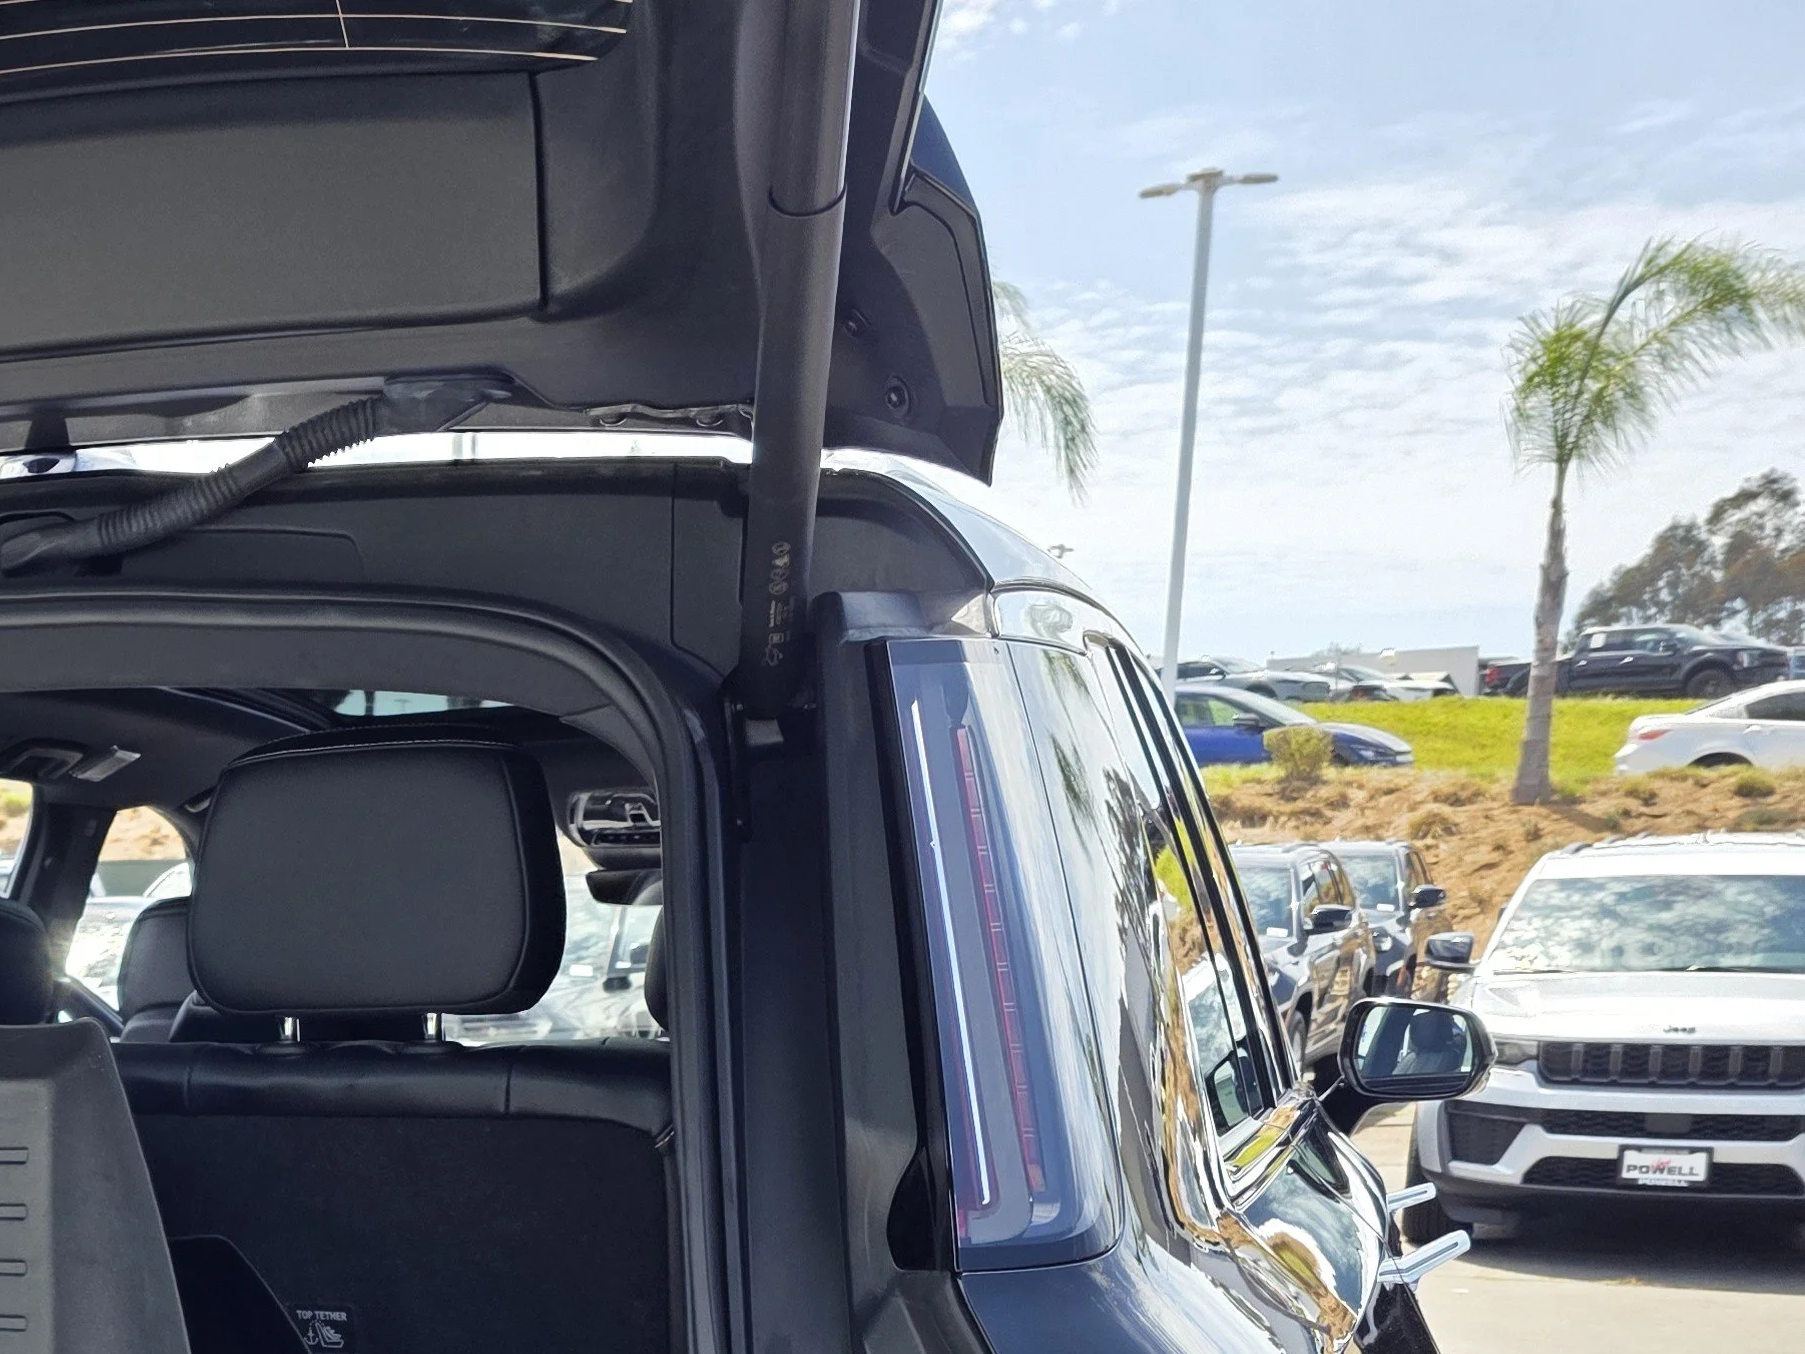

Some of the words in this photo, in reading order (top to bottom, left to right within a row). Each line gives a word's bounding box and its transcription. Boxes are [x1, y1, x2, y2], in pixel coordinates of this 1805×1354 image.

[1626, 1164, 1700, 1177] POWELL
[296, 1309, 314, 1320] TOP
[314, 1310, 348, 1322] TETHER
